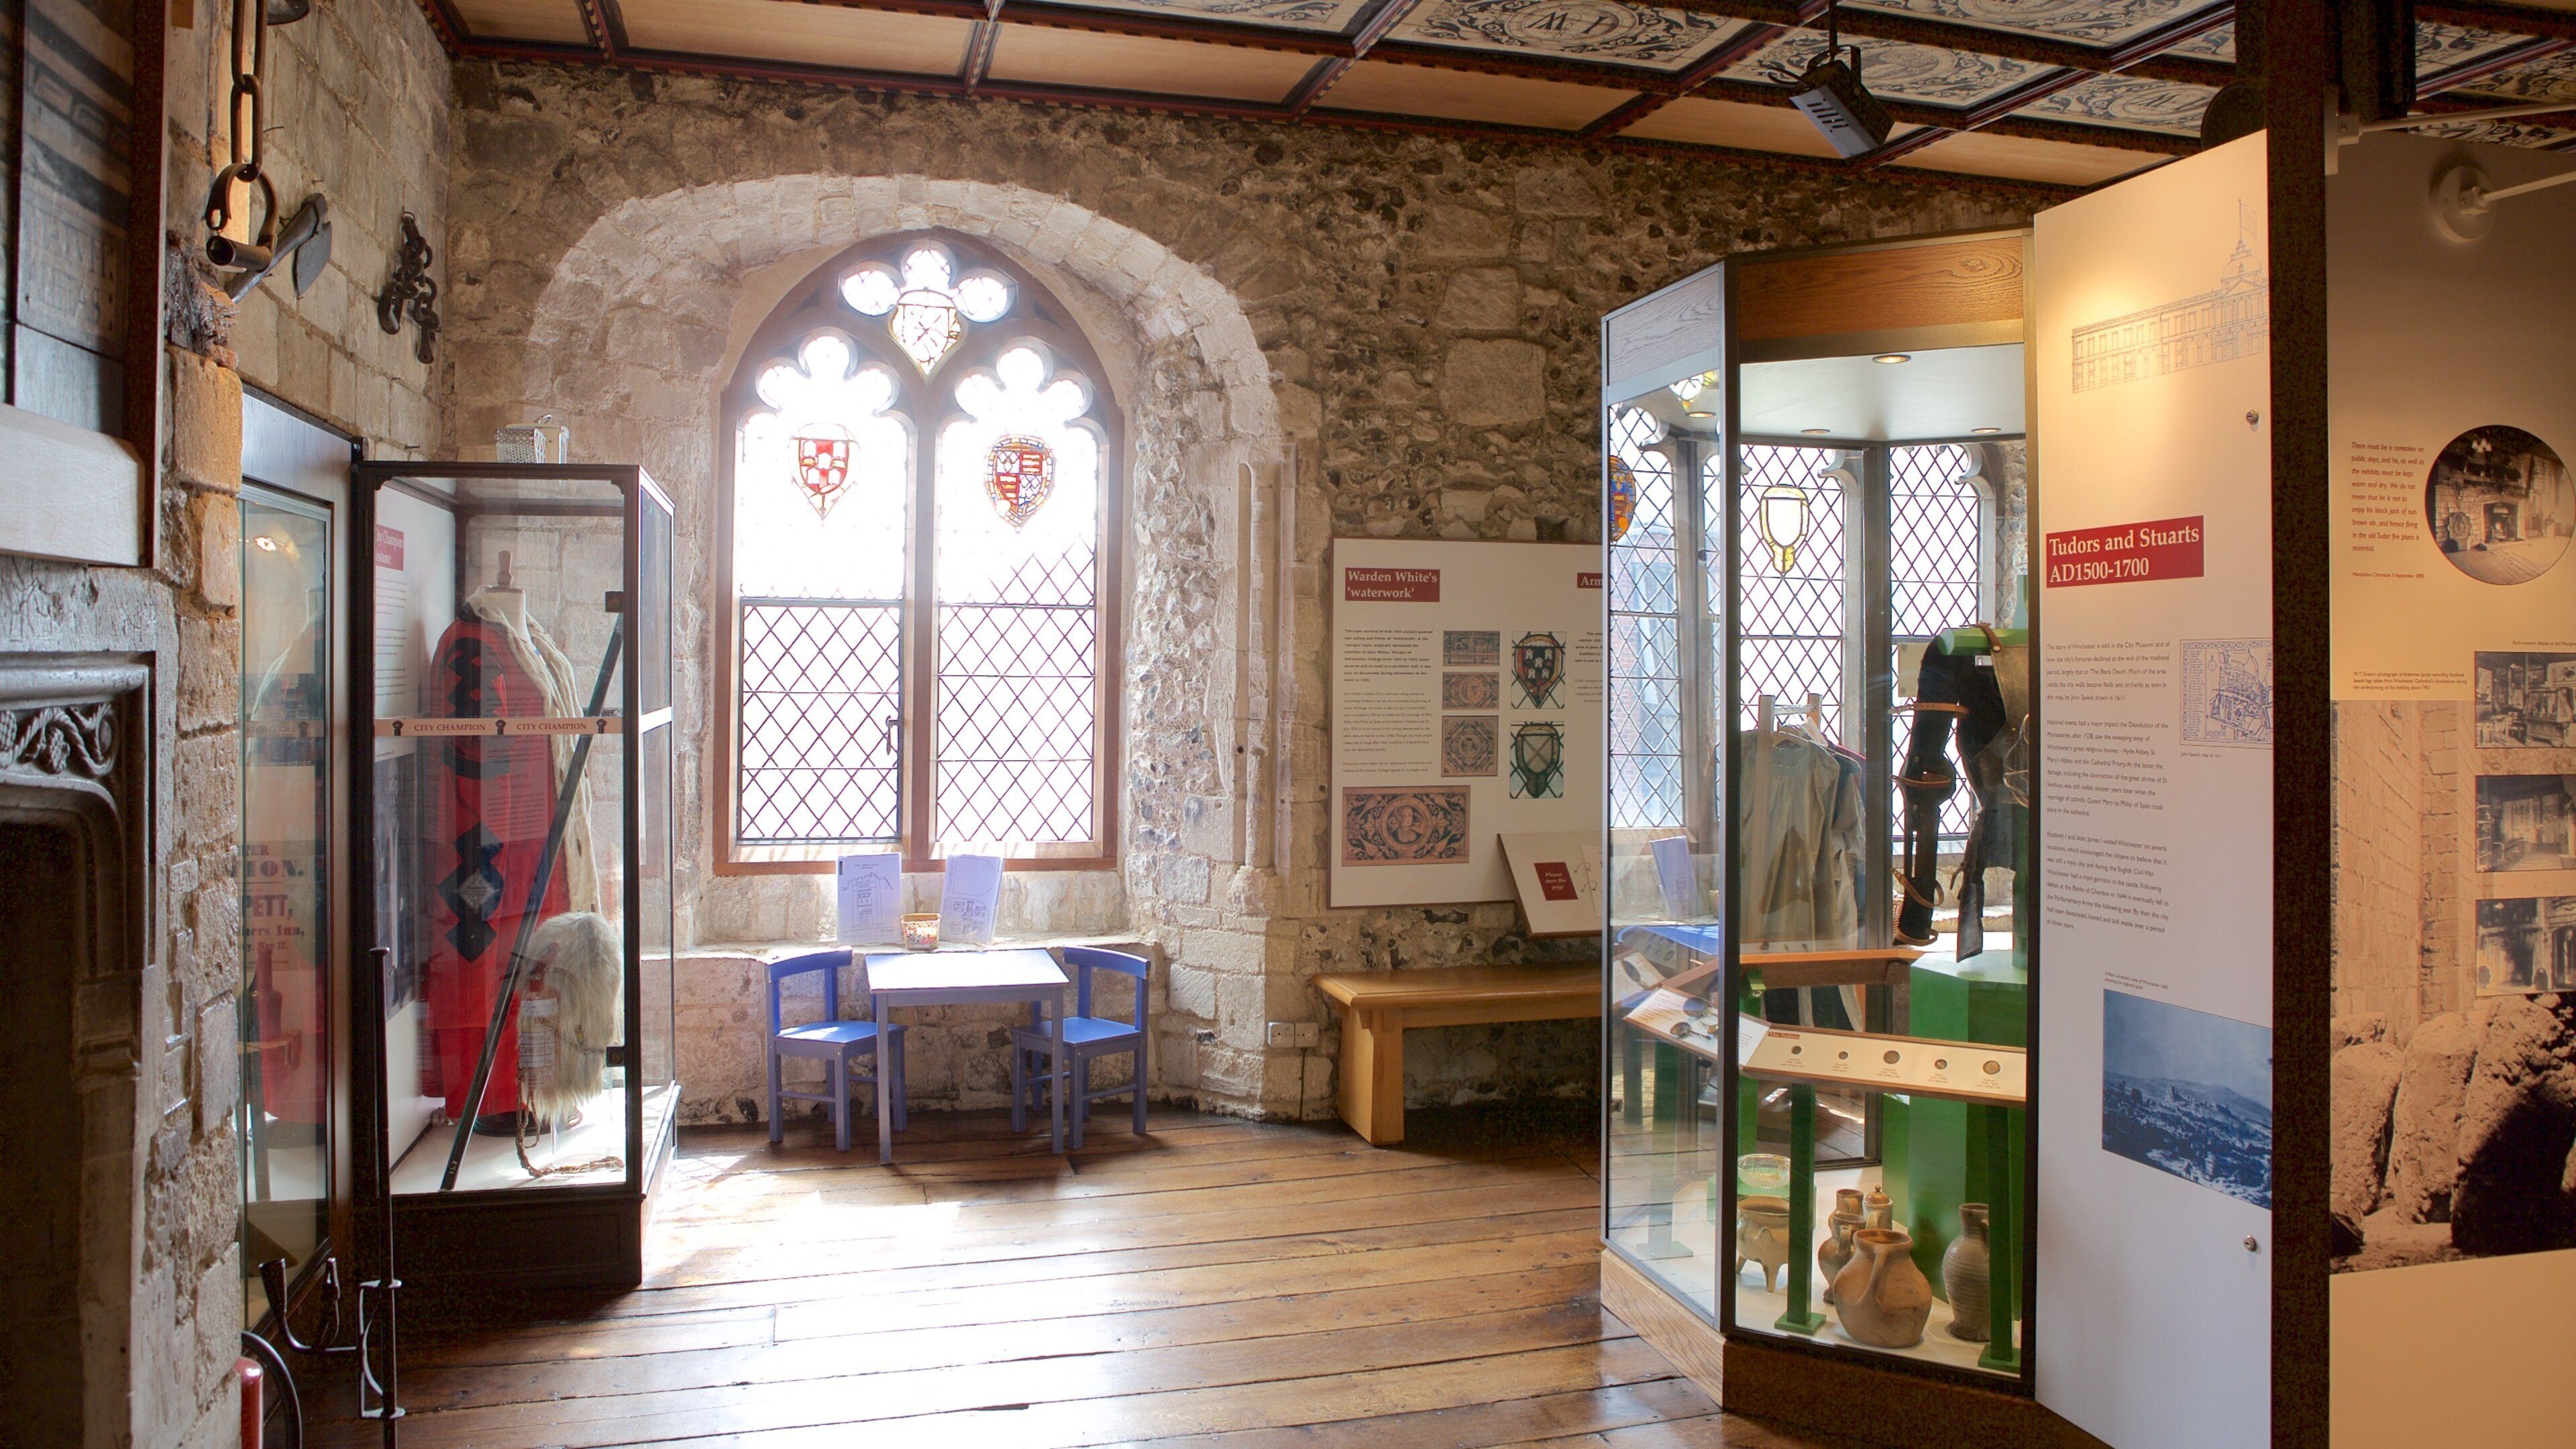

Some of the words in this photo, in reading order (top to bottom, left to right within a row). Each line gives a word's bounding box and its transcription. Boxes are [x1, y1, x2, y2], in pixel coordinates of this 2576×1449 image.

[2351, 455, 2365, 464] public
[2402, 470, 2414, 478] kept
[2353, 506, 2365, 515] enjoy
[2389, 507, 2399, 516] jack
[2405, 521, 2418, 529] firing
[382, 531, 402, 551] Champion
[2049, 535, 2100, 556] Tudors
[2105, 529, 2134, 550] and
[2140, 525, 2200, 547] Stuarts
[2392, 533, 2400, 541] fire
[2401, 534, 2414, 542] place
[2049, 557, 2149, 583] AD1500-1700
[1348, 571, 1391, 582] Warden
[1395, 572, 1438, 583] White's
[1348, 586, 1414, 598] 'waterwork'
